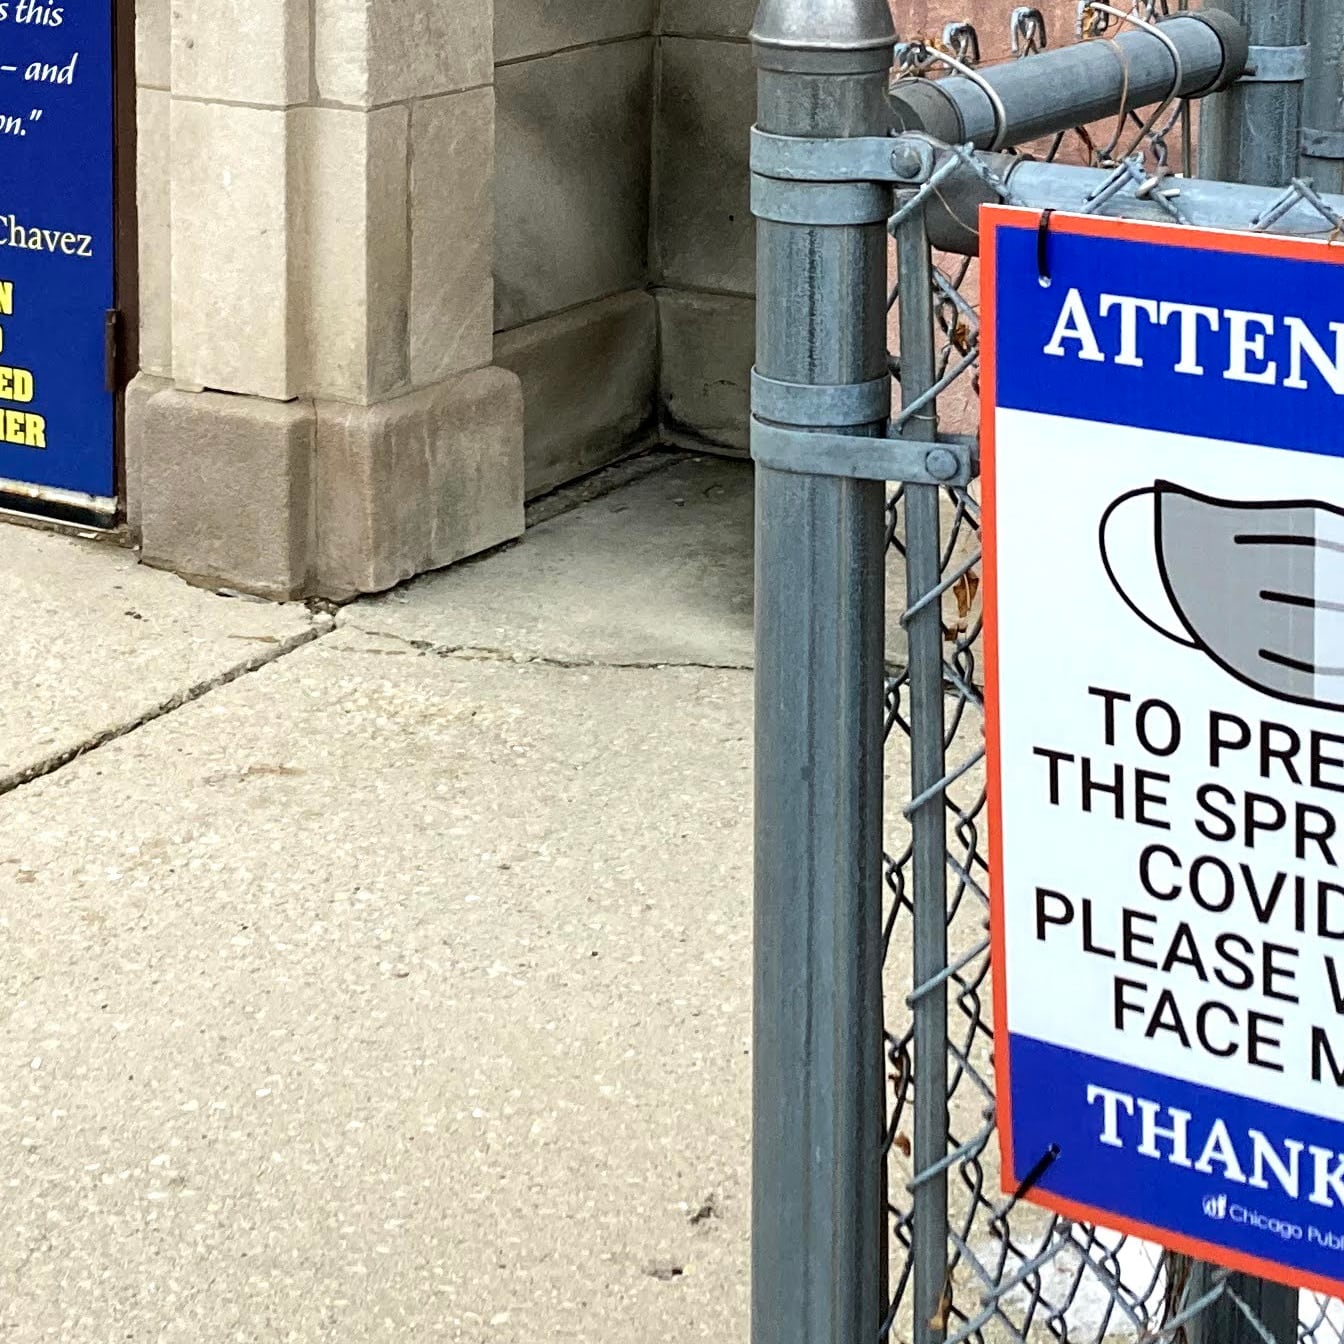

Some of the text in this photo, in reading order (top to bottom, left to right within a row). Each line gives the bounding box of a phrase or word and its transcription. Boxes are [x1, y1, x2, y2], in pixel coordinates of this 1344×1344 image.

[24, 52, 79, 85] and
[1088, 685, 1182, 757] TO
[1032, 746, 1172, 830] THE
[1035, 886, 1300, 1004] PLEASE
[1113, 977, 1285, 1074] FACE
[1229, 1204, 1303, 1240] Chicago
